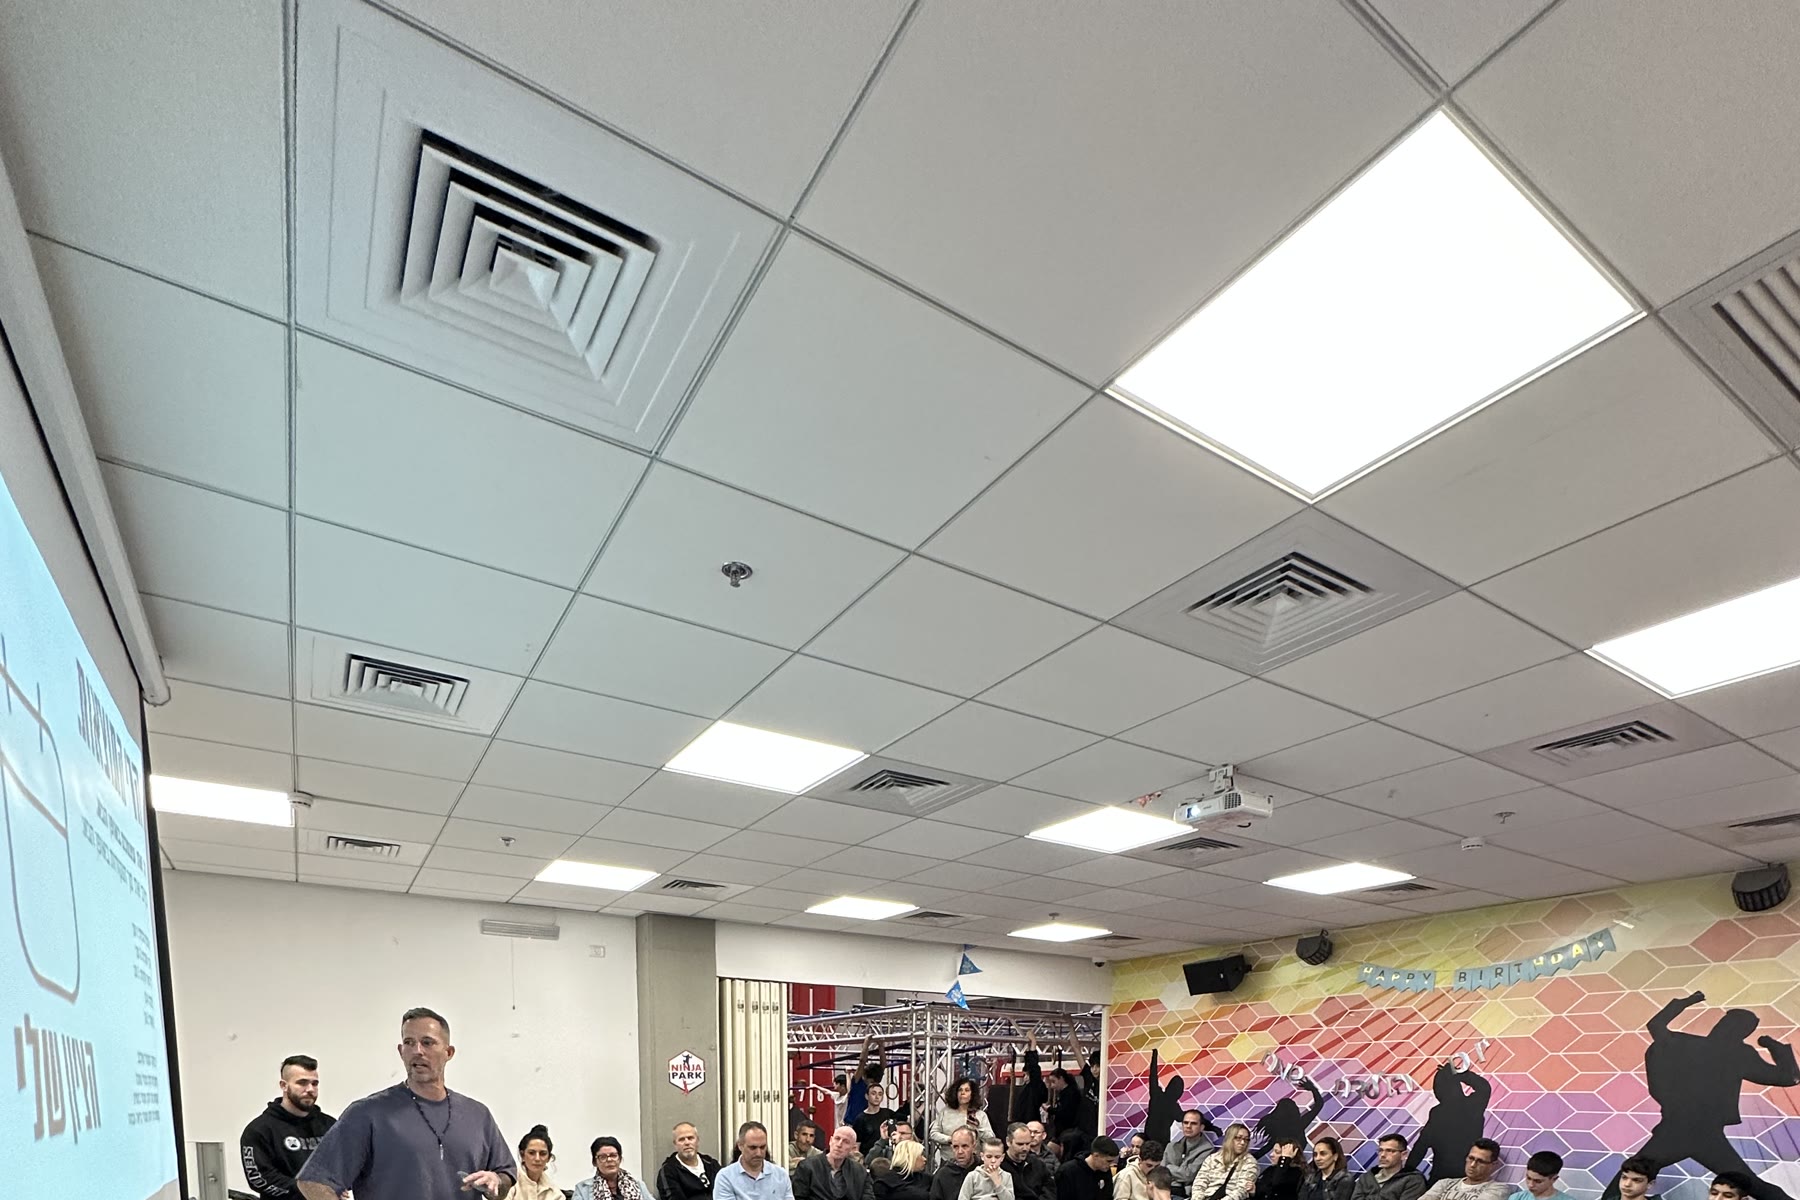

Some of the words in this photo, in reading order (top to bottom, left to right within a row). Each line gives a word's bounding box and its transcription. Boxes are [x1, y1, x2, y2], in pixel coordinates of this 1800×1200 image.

[1363, 966, 1432, 985] HAPPY
[1458, 933, 1606, 984] BIRTHDAY
[14, 1012, 66, 1142] שלי
[671, 1064, 702, 1072] NINJA
